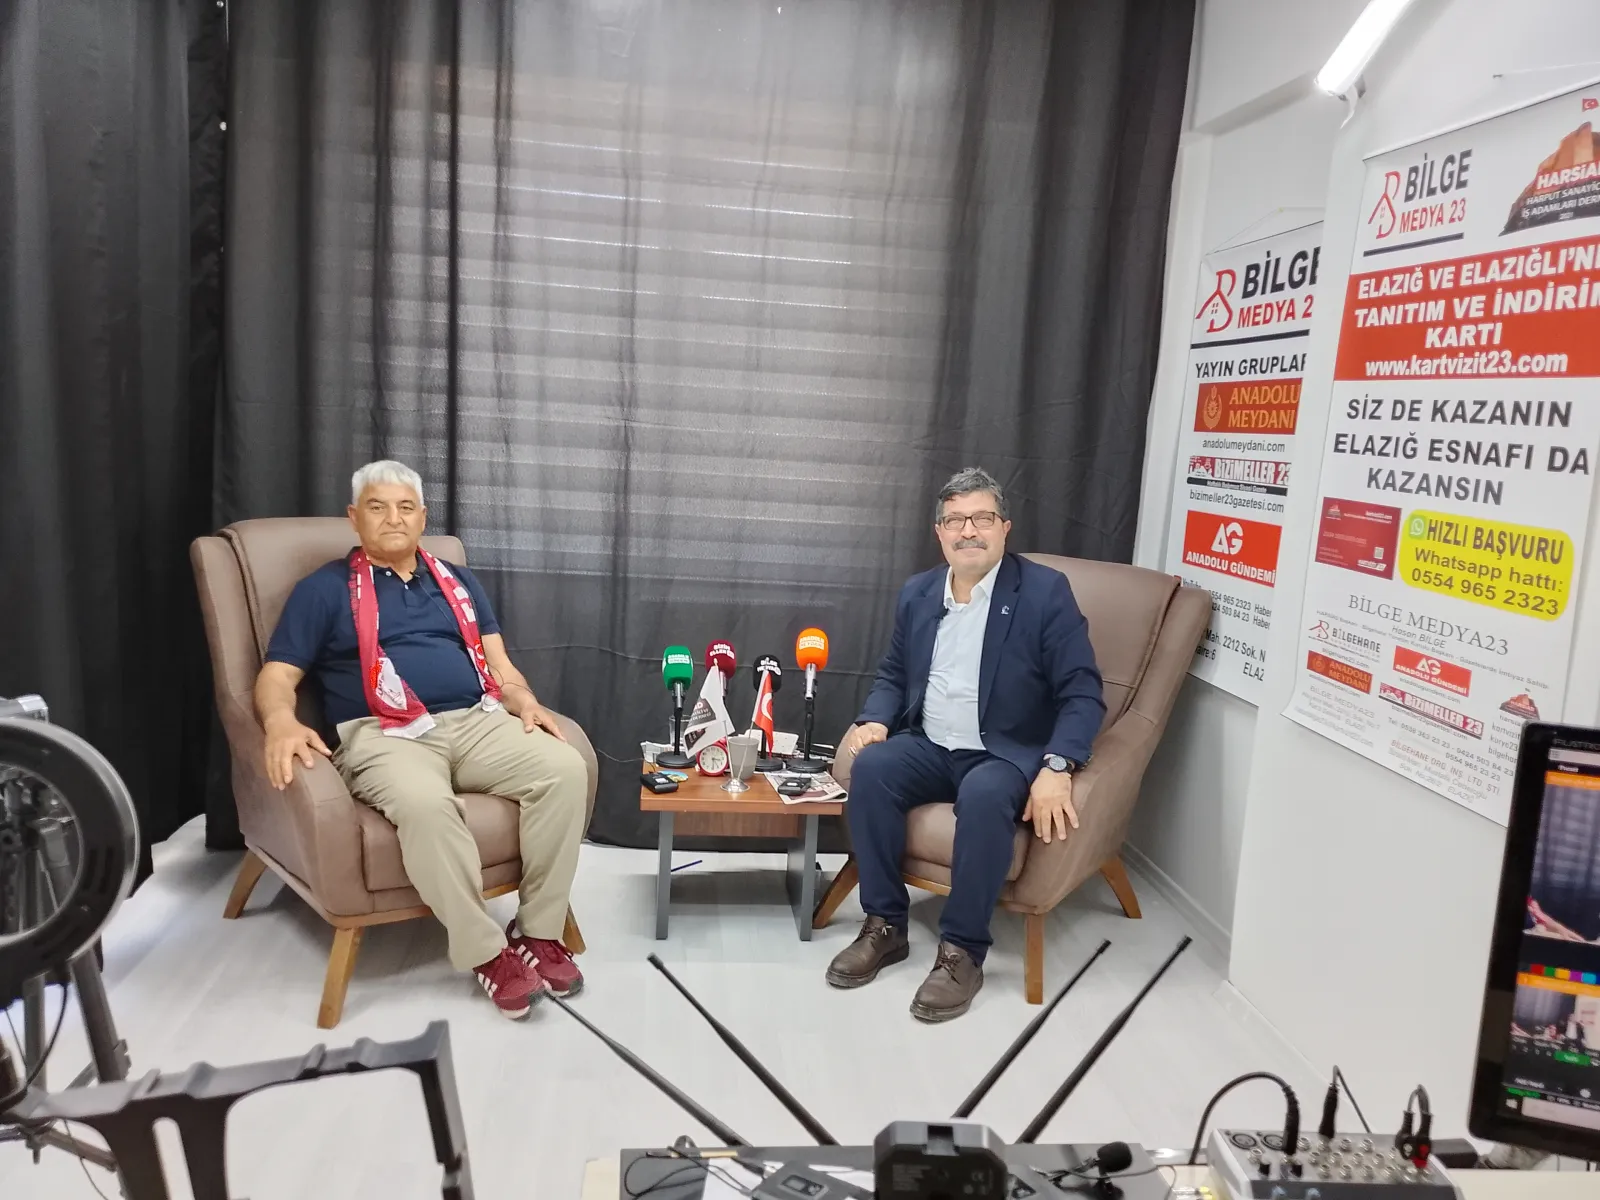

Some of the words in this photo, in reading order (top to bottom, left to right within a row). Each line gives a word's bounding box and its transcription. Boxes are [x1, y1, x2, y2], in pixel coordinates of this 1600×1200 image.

[1404, 149, 1473, 203] BİLGE
[1537, 160, 1600, 190] HARSİA
[1562, 182, 1600, 198] SANAYİC
[1399, 204, 1444, 234] MEDYA
[1449, 198, 1467, 223] 23
[1358, 267, 1423, 300] ELAZIĞ
[1430, 267, 1454, 291] VE
[1237, 298, 1296, 329] MEDYA
[1301, 294, 1315, 319] 2
[1354, 300, 1445, 329] TANITIM
[1453, 295, 1486, 320] VE
[1425, 322, 1503, 349] KARTI
[1195, 360, 1235, 379] YAYIN
[1365, 350, 1569, 377] www.kartvizit23.com
[1229, 384, 1302, 406] ANADOLU
[1227, 408, 1298, 430] MEYDANI
[1346, 394, 1384, 421] SİZ
[1390, 399, 1423, 422] DE
[1430, 399, 1573, 428] KAZANIN
[1202, 438, 1286, 454] anadolumeydani.com
[1333, 431, 1419, 460] ELAZIĞ
[1427, 438, 1535, 470] ESNAFI
[1547, 445, 1590, 476] DA
[1189, 489, 1285, 514] bizimeller23gazetesi.com
[1366, 467, 1505, 506] KAZANSIN
[1210, 522, 1244, 556] AG
[1426, 518, 1470, 549] HIZLI
[1472, 526, 1565, 566] BAŞVURU
[1185, 550, 1229, 572] ANADOLU
[1230, 561, 1277, 585] GÜNDEMİ
[1413, 547, 1503, 583] Whatsapp
[1223, 594, 1235, 605] 965
[1235, 598, 1252, 611] 2323
[1412, 567, 1456, 591] 0554
[1460, 577, 1497, 602] 965
[1503, 588, 1560, 616] 2323
[1221, 605, 1233, 617] 503
[1233, 608, 1241, 619] 84
[1241, 612, 1250, 623] 23
[1348, 594, 1403, 624] BİLGE
[1407, 611, 1509, 657] MEDYA23
[1391, 625, 1418, 641] Hasan
[1222, 635, 1240, 653] 2212
[1241, 642, 1258, 660] Sok.
[1259, 648, 1267, 663] N
[1243, 662, 1265, 682] ELAZ
[1329, 660, 1371, 683] ANADOLU
[1395, 663, 1431, 681] ANADOLU
[1429, 675, 1468, 695] GÜNDEMİ
[1464, 718, 1484, 738] 23
[1445, 751, 1463, 765] 0554
[1479, 767, 1490, 779] 23
[1490, 772, 1501, 783] 23
[1504, 767, 1515, 779] 23
